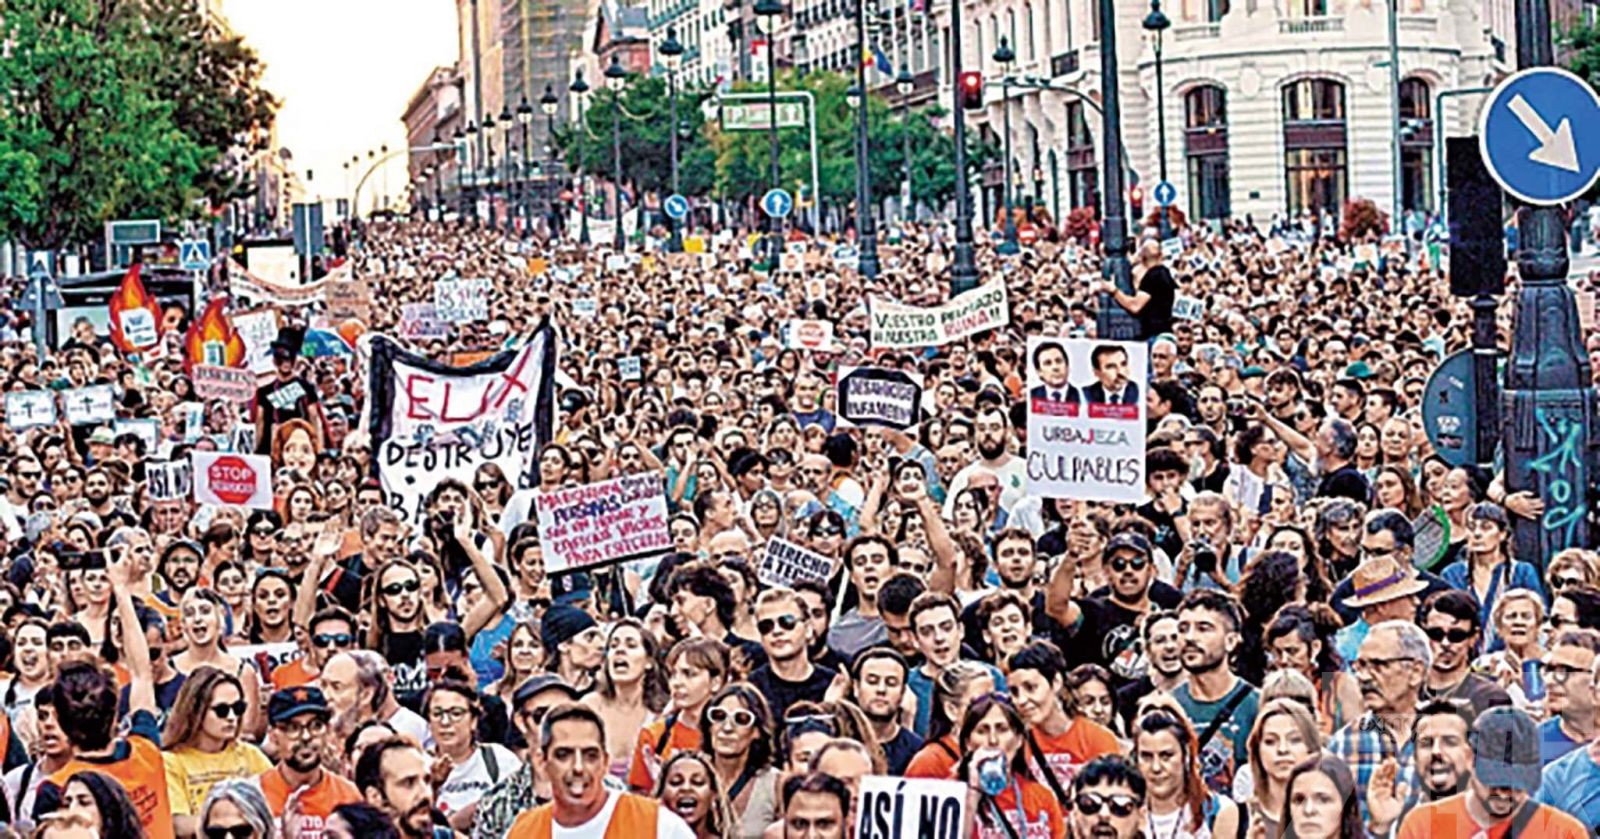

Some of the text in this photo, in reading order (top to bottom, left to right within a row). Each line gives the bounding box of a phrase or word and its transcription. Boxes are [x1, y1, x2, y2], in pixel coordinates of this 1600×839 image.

[874, 312, 935, 329] VUESTRO
[387, 422, 533, 472] DESTRUYE
[210, 464, 251, 481] STOP
[1026, 450, 1141, 487] CULPABLES
[767, 539, 831, 577] DERECHO
[859, 780, 907, 839] ASÍ
[918, 793, 961, 839] NO
